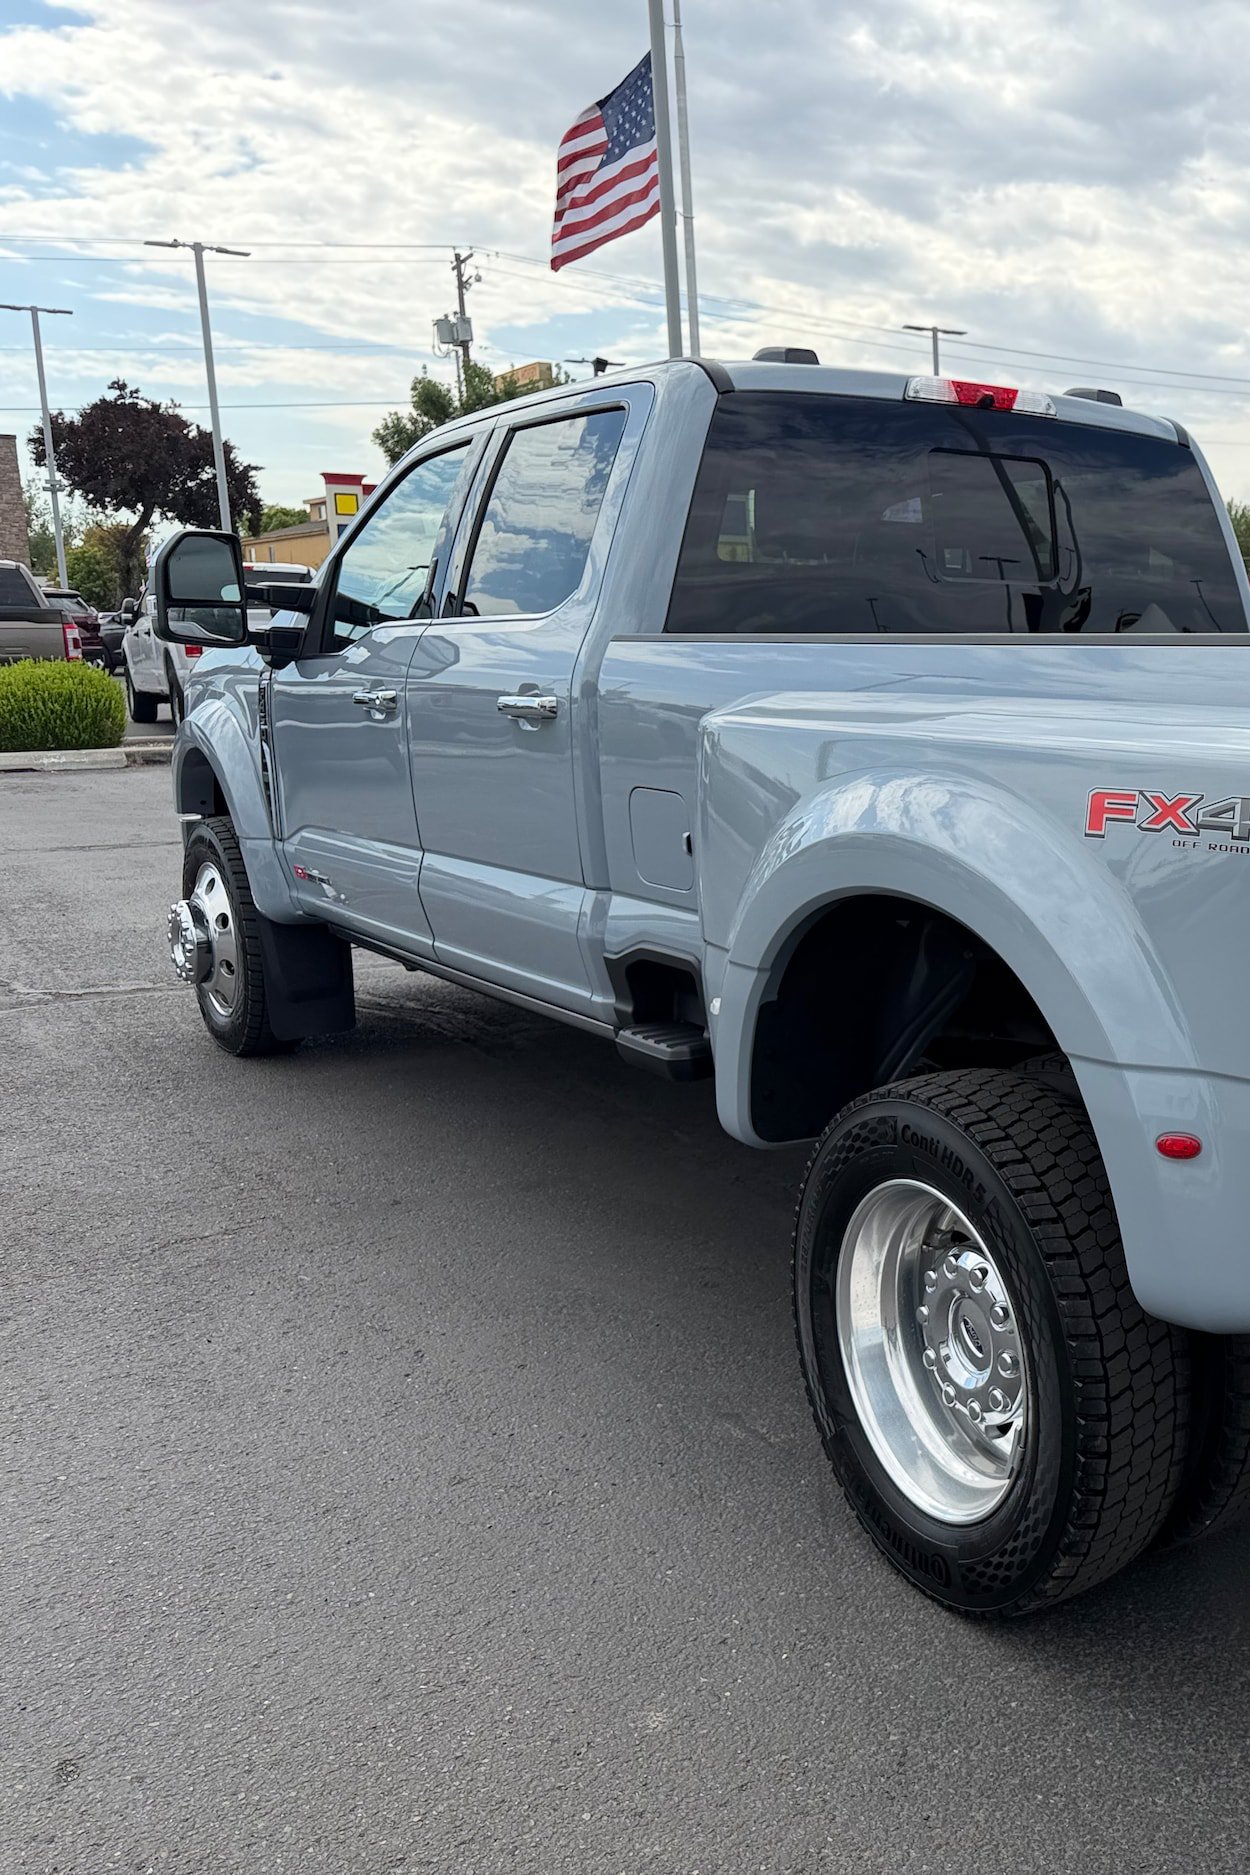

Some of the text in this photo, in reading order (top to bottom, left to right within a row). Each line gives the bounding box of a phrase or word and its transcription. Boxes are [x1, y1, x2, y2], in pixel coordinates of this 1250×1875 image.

[1172, 840, 1250, 855] OFF ROAD
[901, 1124, 988, 1203] Conti HDR 5
